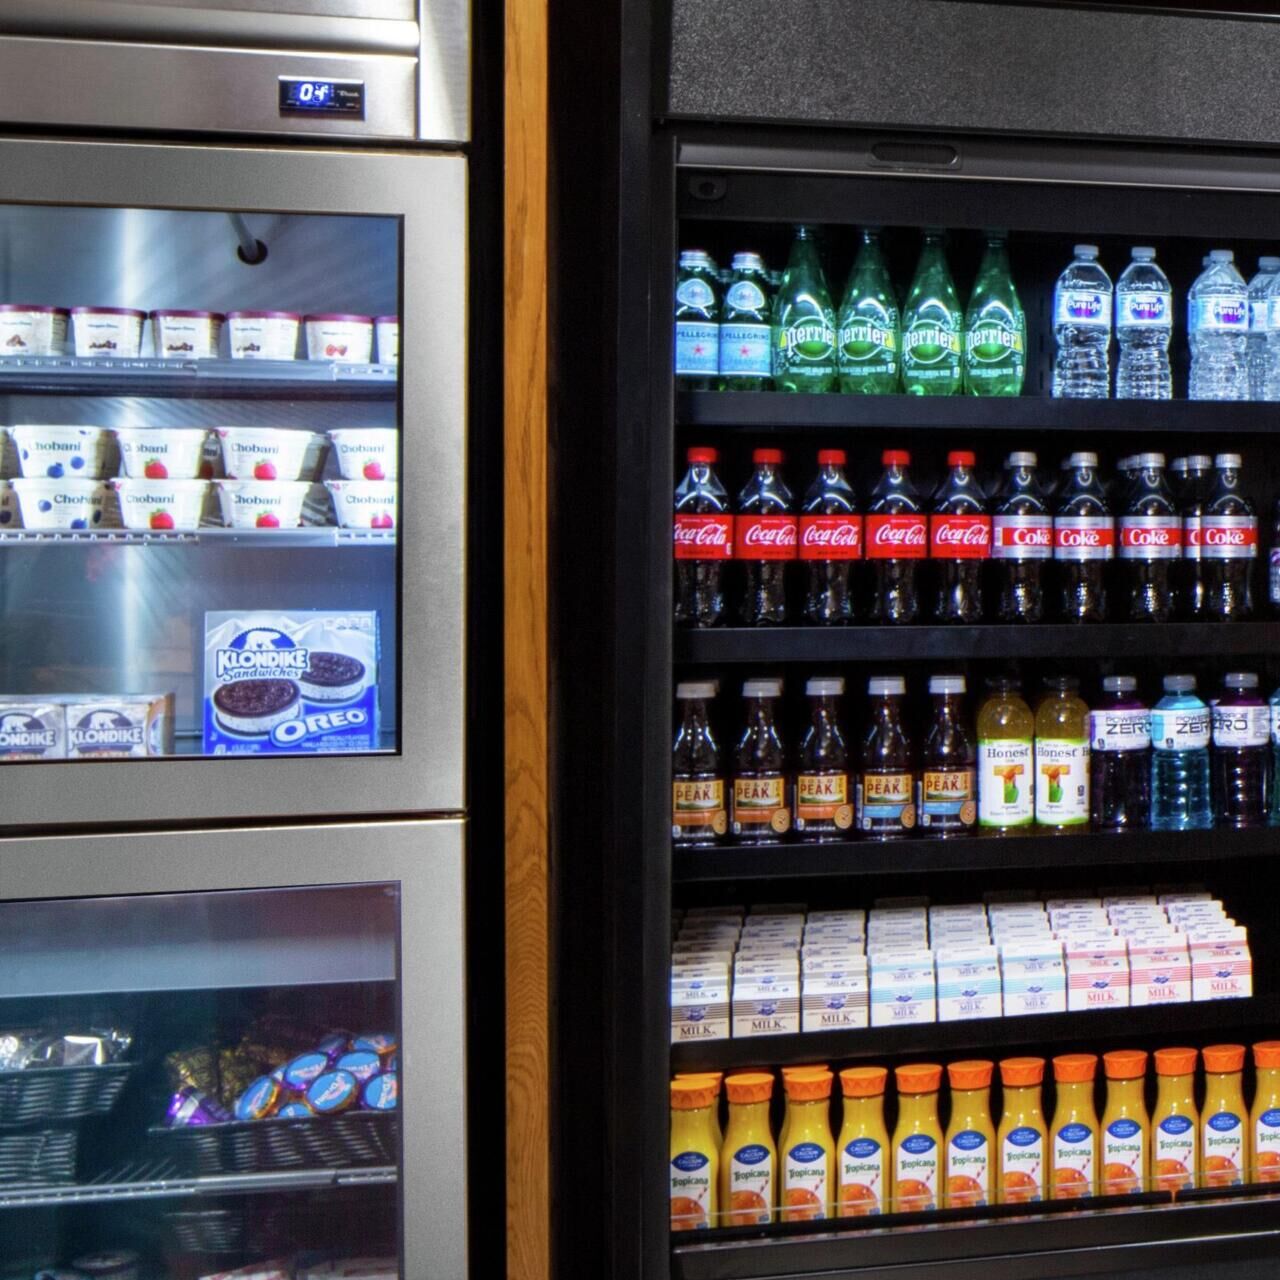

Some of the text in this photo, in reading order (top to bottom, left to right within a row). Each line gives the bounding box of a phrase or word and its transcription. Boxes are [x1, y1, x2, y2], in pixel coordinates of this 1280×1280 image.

[1060, 529, 1100, 546] Coke
[1129, 529, 1169, 546] Coke
[1206, 529, 1245, 546] Coke
[217, 649, 309, 678] KLONDIKE
[223, 667, 305, 681] Sandwiches
[274, 709, 367, 742] OREO
[69, 727, 144, 750] KLONDIKE
[987, 748, 1030, 757] Honest
[801, 784, 833, 796] PEAK
[868, 783, 905, 795] PEAK
[922, 780, 960, 793] PEAK
[676, 790, 713, 801] PEAK
[737, 788, 775, 800] PEAK
[1148, 986, 1177, 998] MILK
[1211, 980, 1240, 992] MILK
[1087, 990, 1117, 1003] MILK
[822, 1012, 850, 1025] MILK
[681, 1025, 711, 1037] MILK
[752, 1020, 782, 1033] MILK
[1160, 1139, 1192, 1150] Tropicana
[1208, 1135, 1241, 1147] Tropicana
[1058, 1147, 1091, 1158] Tropicana
[1108, 1143, 1141, 1154] Tropicana
[1007, 1150, 1041, 1161] Tropicana
[846, 1163, 881, 1174] Tropicana
[902, 1159, 936, 1170] Tropicana
[735, 1169, 770, 1181] Tropicana
[789, 1168, 824, 1179] Tropicana
[674, 1175, 709, 1187] Tropicana
